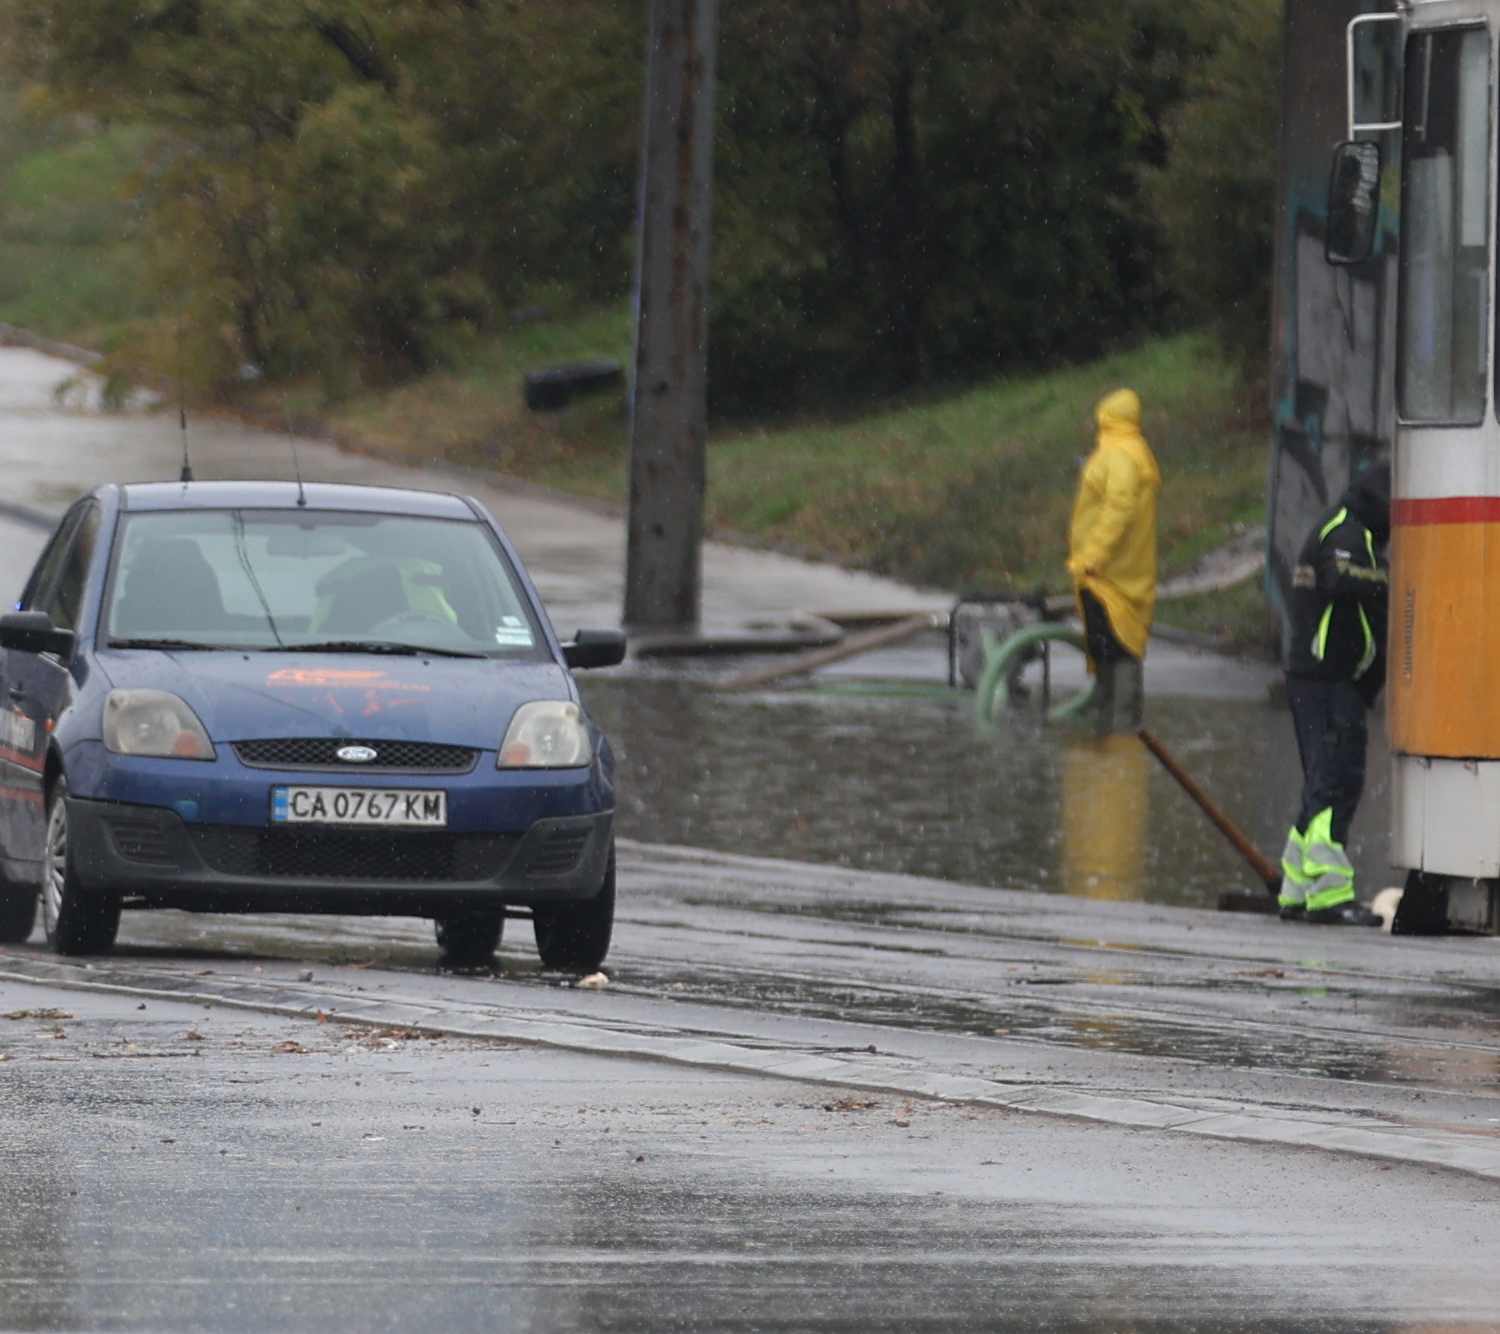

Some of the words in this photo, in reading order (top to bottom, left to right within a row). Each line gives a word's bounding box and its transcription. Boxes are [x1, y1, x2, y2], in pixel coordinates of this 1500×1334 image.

[291, 791, 328, 818] CA
[333, 791, 399, 819] 0767
[405, 794, 441, 821] KM
